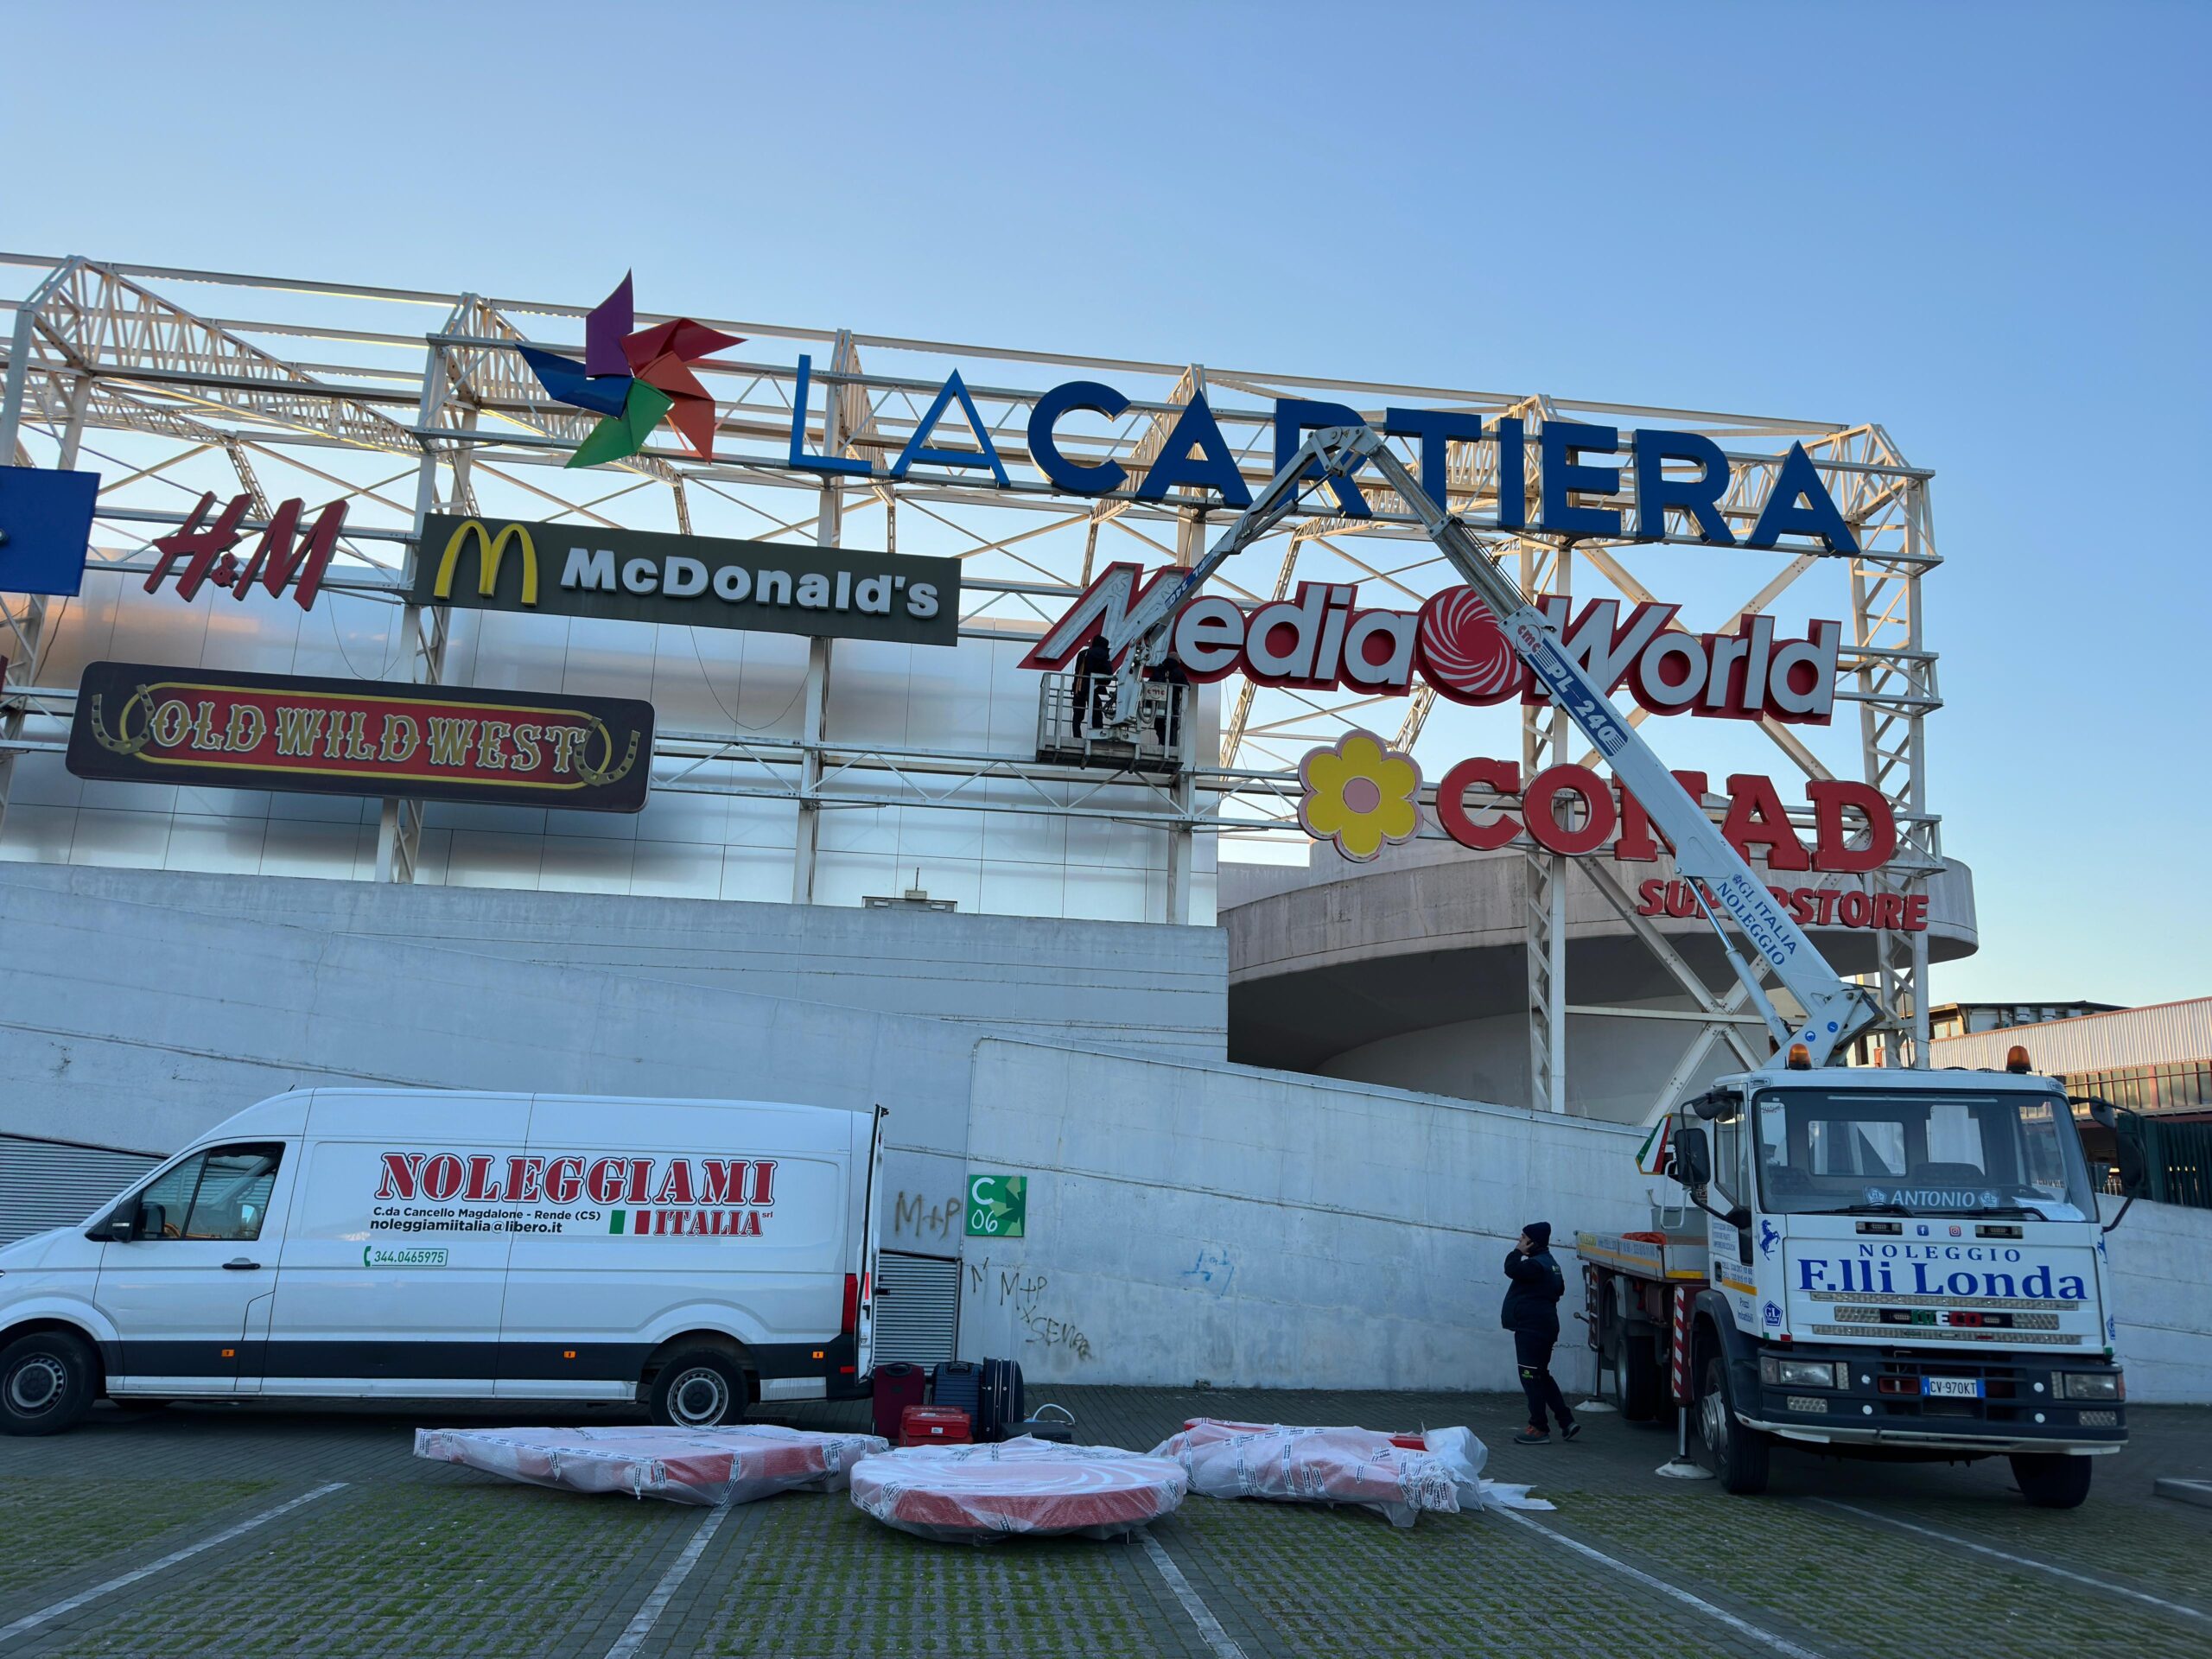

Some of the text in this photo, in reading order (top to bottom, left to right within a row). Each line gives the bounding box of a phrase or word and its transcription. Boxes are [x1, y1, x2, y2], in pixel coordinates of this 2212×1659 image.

[143, 490, 350, 612] H&M
[560, 547, 939, 620] McDonald's
[1517, 624, 1541, 654] cmc
[1574, 700, 1618, 741] 240
[149, 699, 586, 775] OLD WILD WEST
[1717, 881, 1785, 966] NOLEGGIO
[1738, 881, 1797, 956] GL ITALIA
[373, 1152, 779, 1206] NOLEGGIAMI
[972, 1177, 995, 1205] C
[1891, 1190, 1976, 1207] ANTONIO
[370, 1218, 563, 1235] noleggiamiitalia@libero.it
[373, 1206, 400, 1217] C.da
[404, 1207, 455, 1218] Cancello
[458, 1208, 524, 1220] Magdalone
[534, 1211, 572, 1220] Rende
[575, 1210, 601, 1221] (CS)
[654, 1210, 764, 1237] ITALIA
[971, 1209, 998, 1233] 06
[374, 1250, 444, 1264] 344.0465975
[1859, 1243, 2021, 1263] NOLEGGIO
[1798, 1258, 2088, 1300] F.lli Londa
[1764, 1306, 1780, 1318] GL
[1911, 1309, 1982, 1327] IVECO
